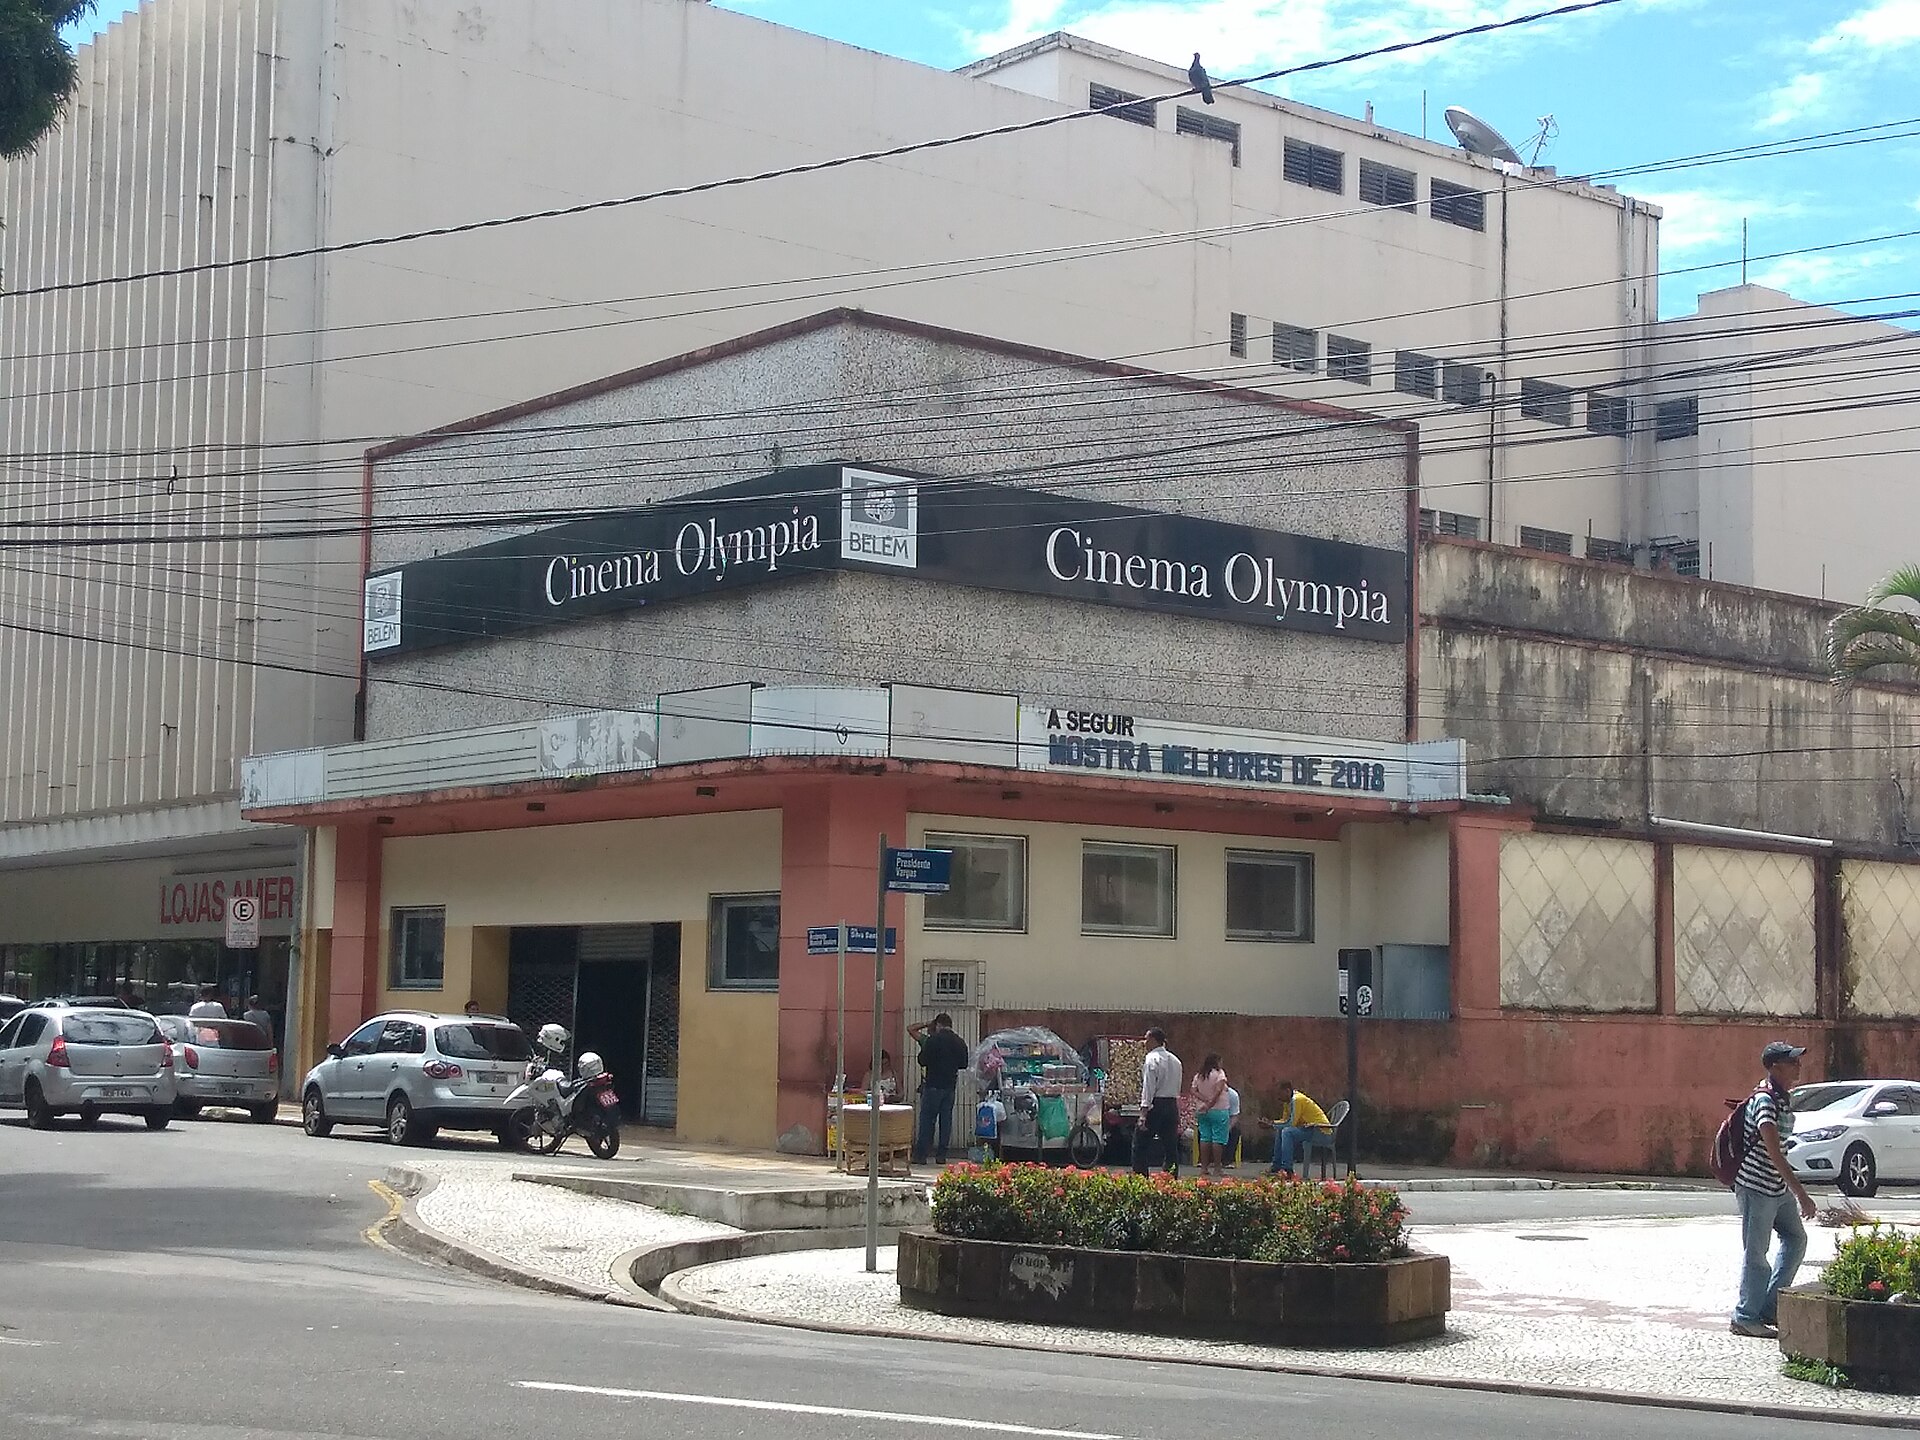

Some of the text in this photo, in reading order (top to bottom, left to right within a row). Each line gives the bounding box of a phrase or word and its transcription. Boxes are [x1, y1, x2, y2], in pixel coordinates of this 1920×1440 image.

[544, 506, 820, 606] Cinema Olympia
[1046, 528, 1391, 629] Cinema Olympia
[1047, 709, 1134, 737] A SEGUIR
[1049, 734, 1385, 792] MOSTRA MELHORES DE 2018
[160, 880, 226, 924] LOJAS
[240, 903, 249, 917] E
